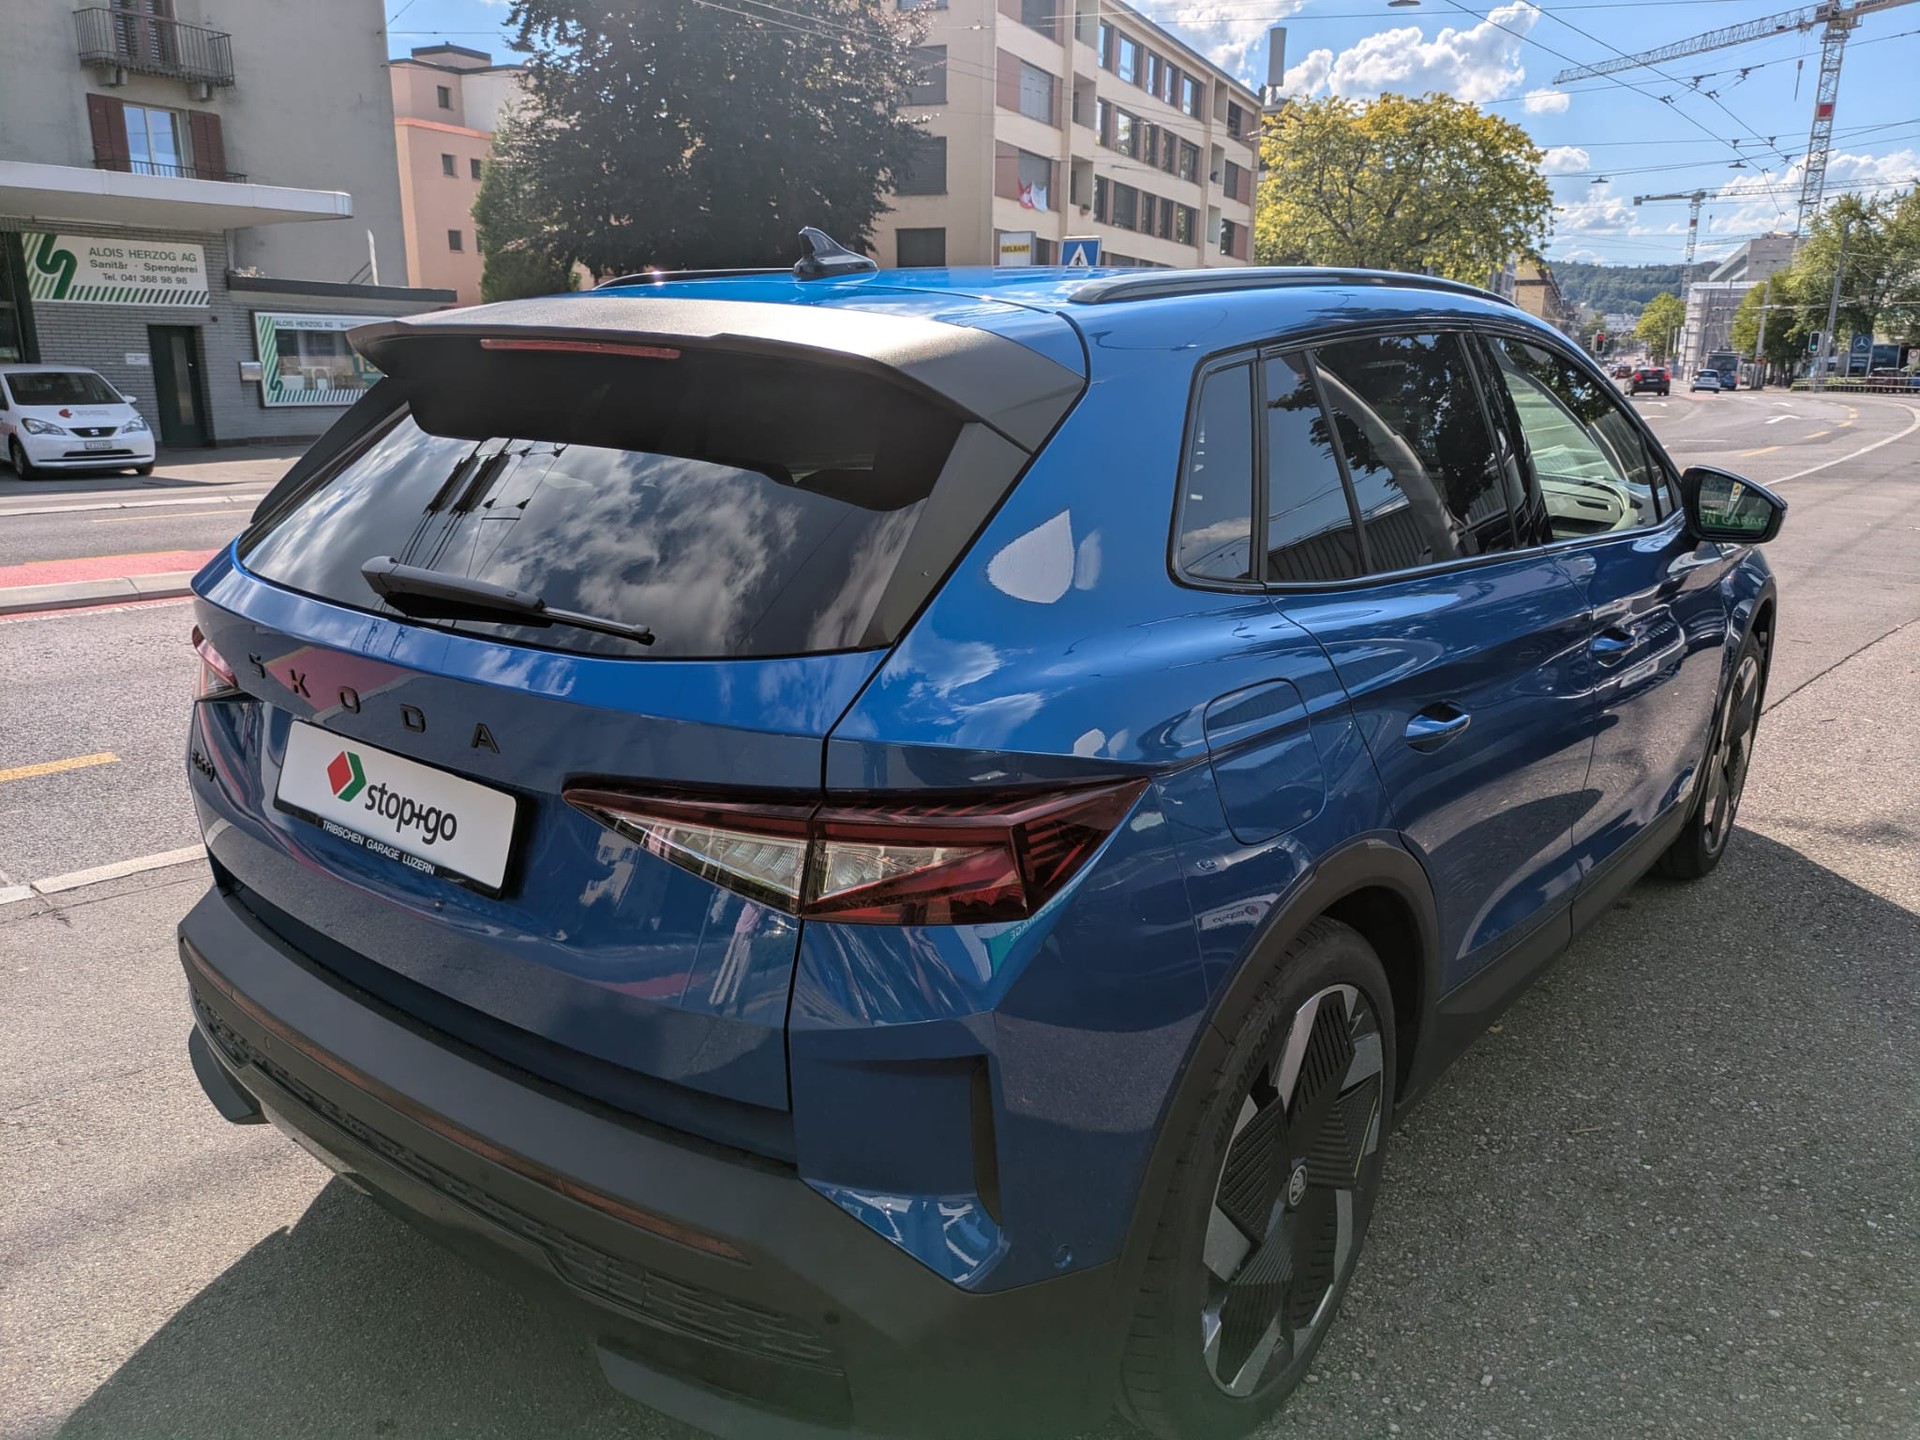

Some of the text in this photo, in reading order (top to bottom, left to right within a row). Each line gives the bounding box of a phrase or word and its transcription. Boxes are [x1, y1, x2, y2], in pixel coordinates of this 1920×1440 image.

[89, 247, 197, 262] ALOIS HERZOG AG
[90, 259, 198, 274] Sanitär Spenglerei
[102, 272, 118, 281] Tel.
[120, 273, 137, 282] 041
[364, 782, 458, 845] stop+go
[322, 820, 436, 875] TRIBSCHEN GARAGE LUZERN
